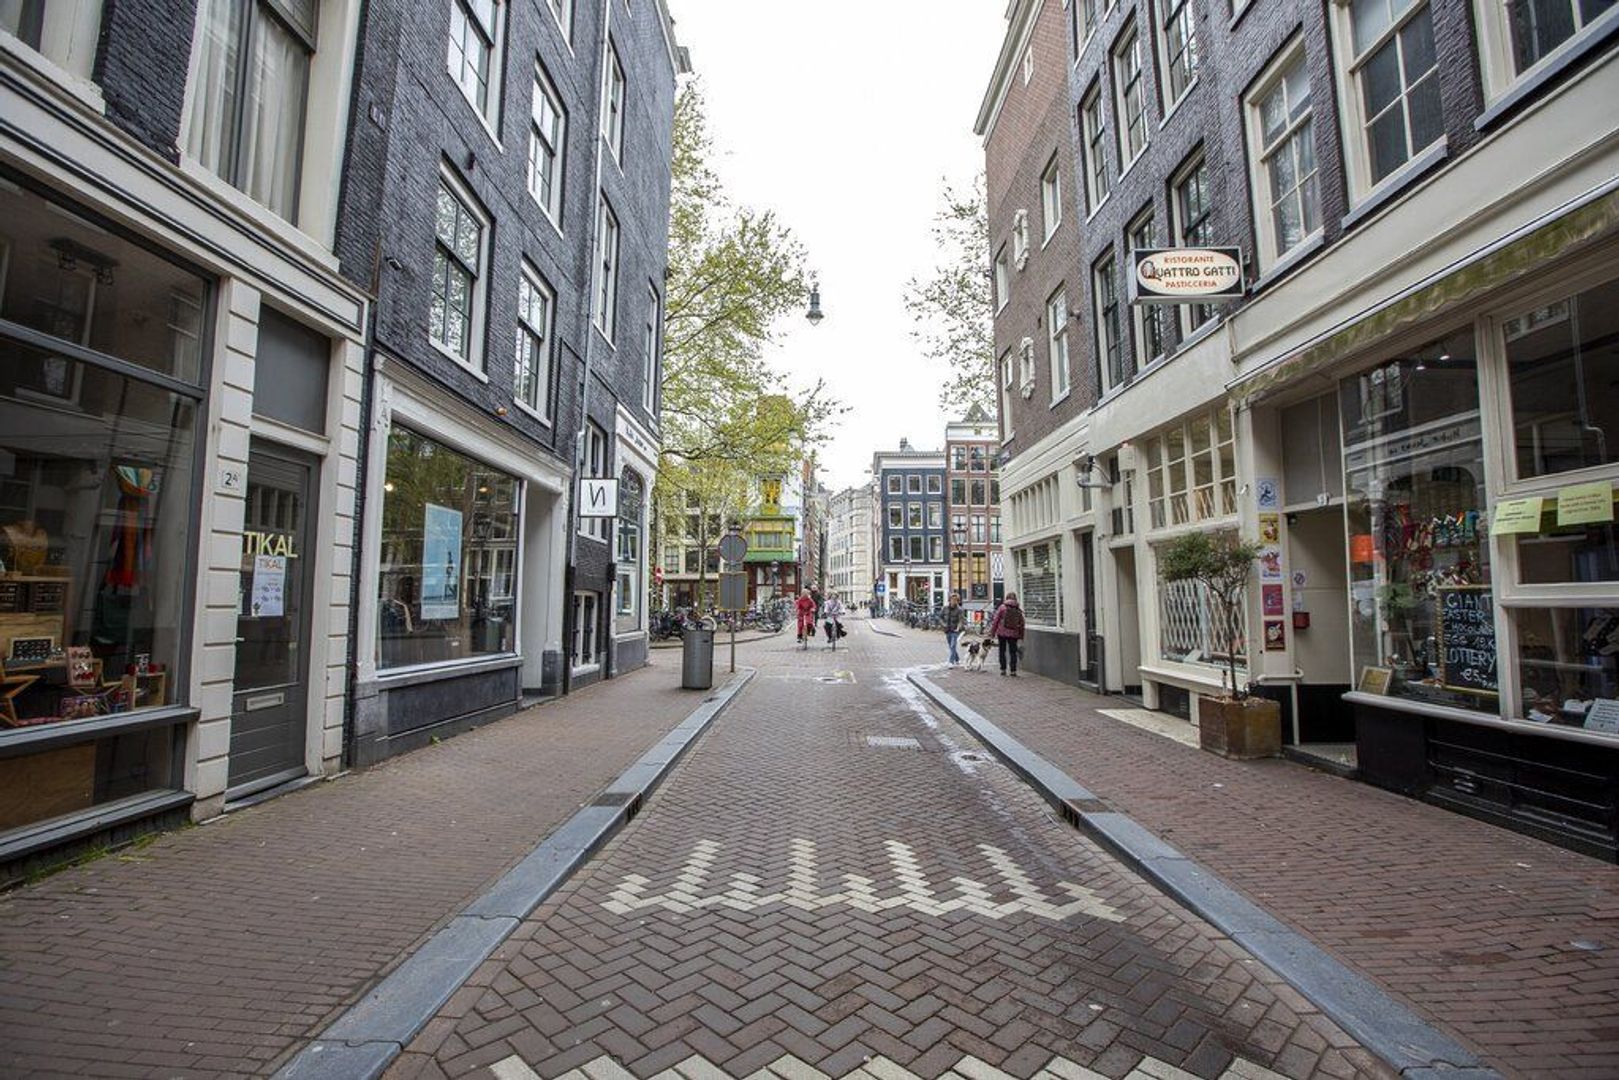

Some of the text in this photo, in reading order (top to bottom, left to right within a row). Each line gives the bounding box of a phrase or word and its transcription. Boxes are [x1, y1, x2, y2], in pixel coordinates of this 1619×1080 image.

[1141, 260, 1235, 281] QUATTRO GATTI
[243, 531, 298, 557] TIKAL
[258, 558, 284, 570] TIKAL
[1444, 646, 1496, 673] LOTTERY
